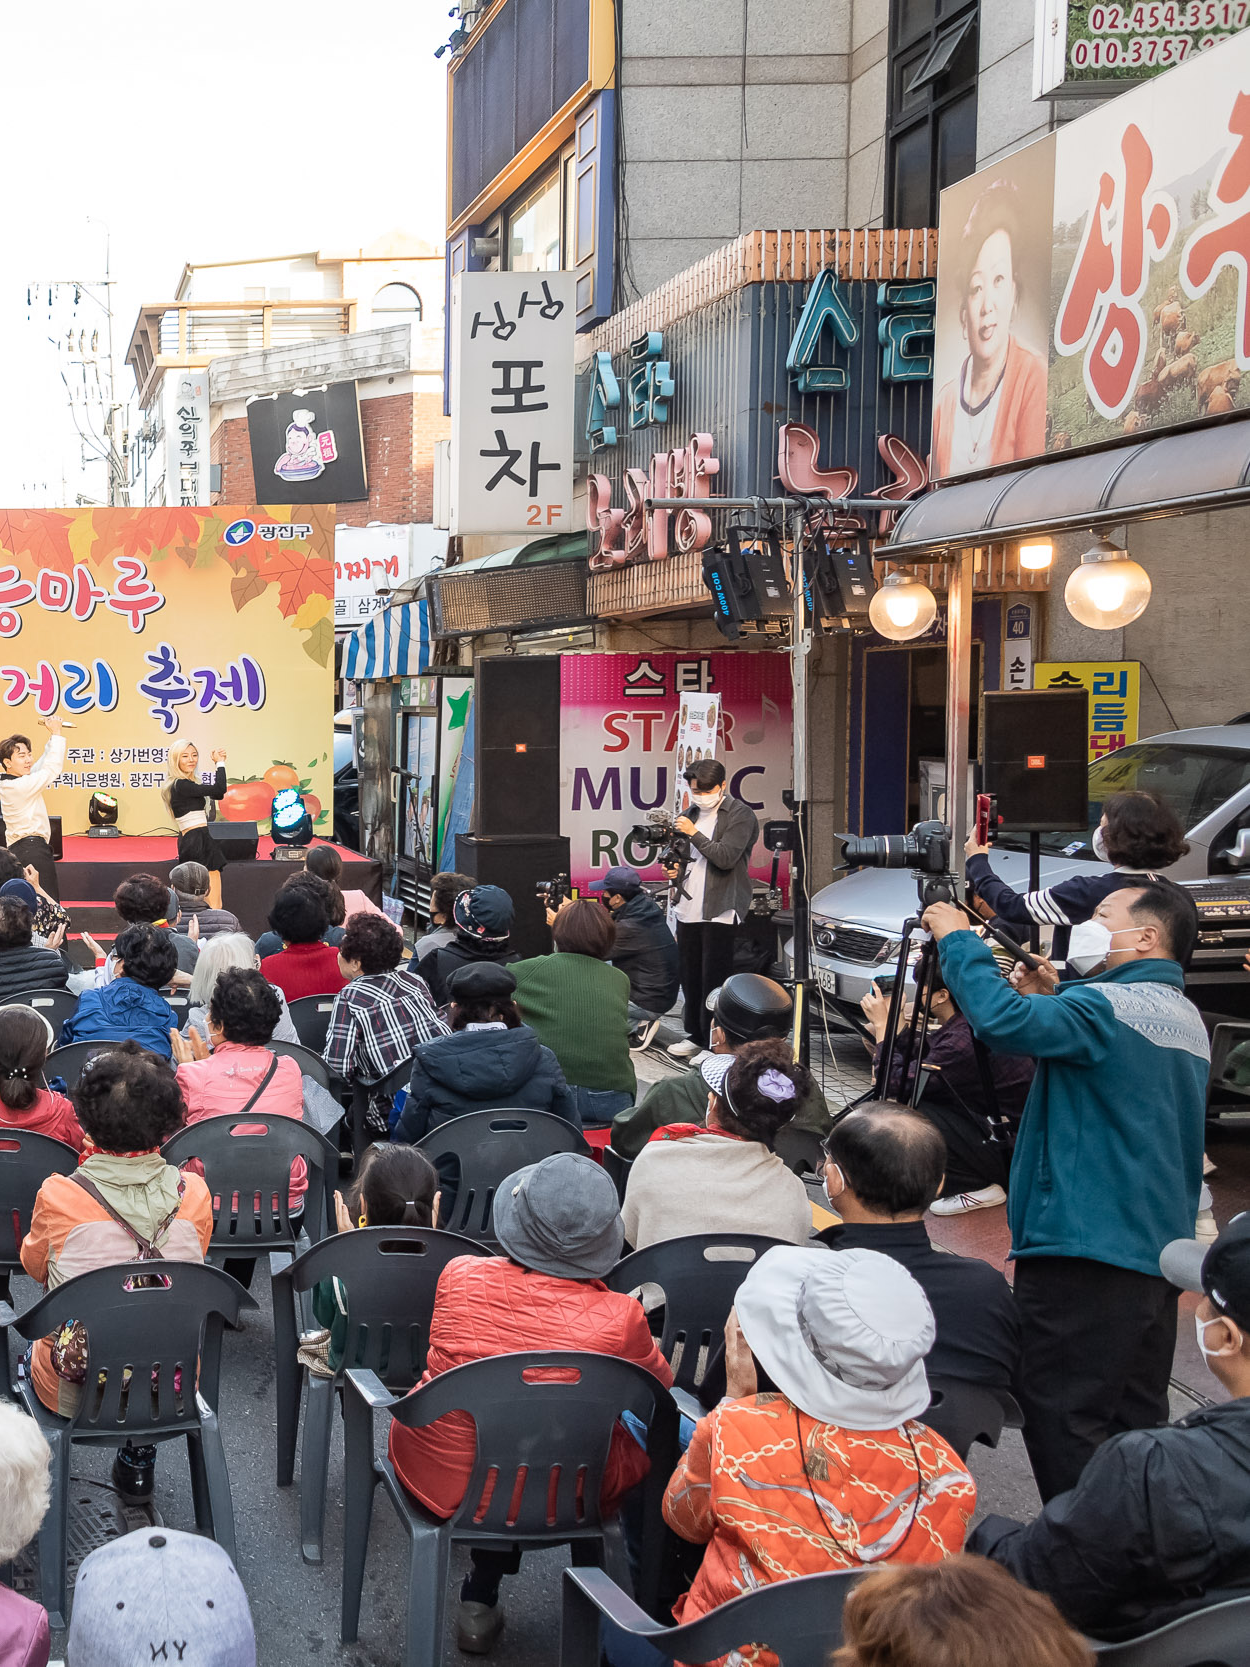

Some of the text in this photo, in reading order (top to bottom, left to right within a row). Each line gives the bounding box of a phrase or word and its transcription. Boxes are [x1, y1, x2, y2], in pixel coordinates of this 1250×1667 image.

[470, 280, 564, 341] 상상
[526, 505, 562, 526] 2F
[257, 524, 314, 541] 광진구
[1012, 620, 1025, 635] 40
[139, 640, 267, 735] 축제
[623, 659, 715, 698] 스타
[67, 748, 95, 764] 주관
[130, 773, 165, 788] 광진구
[571, 765, 766, 811] MUC
